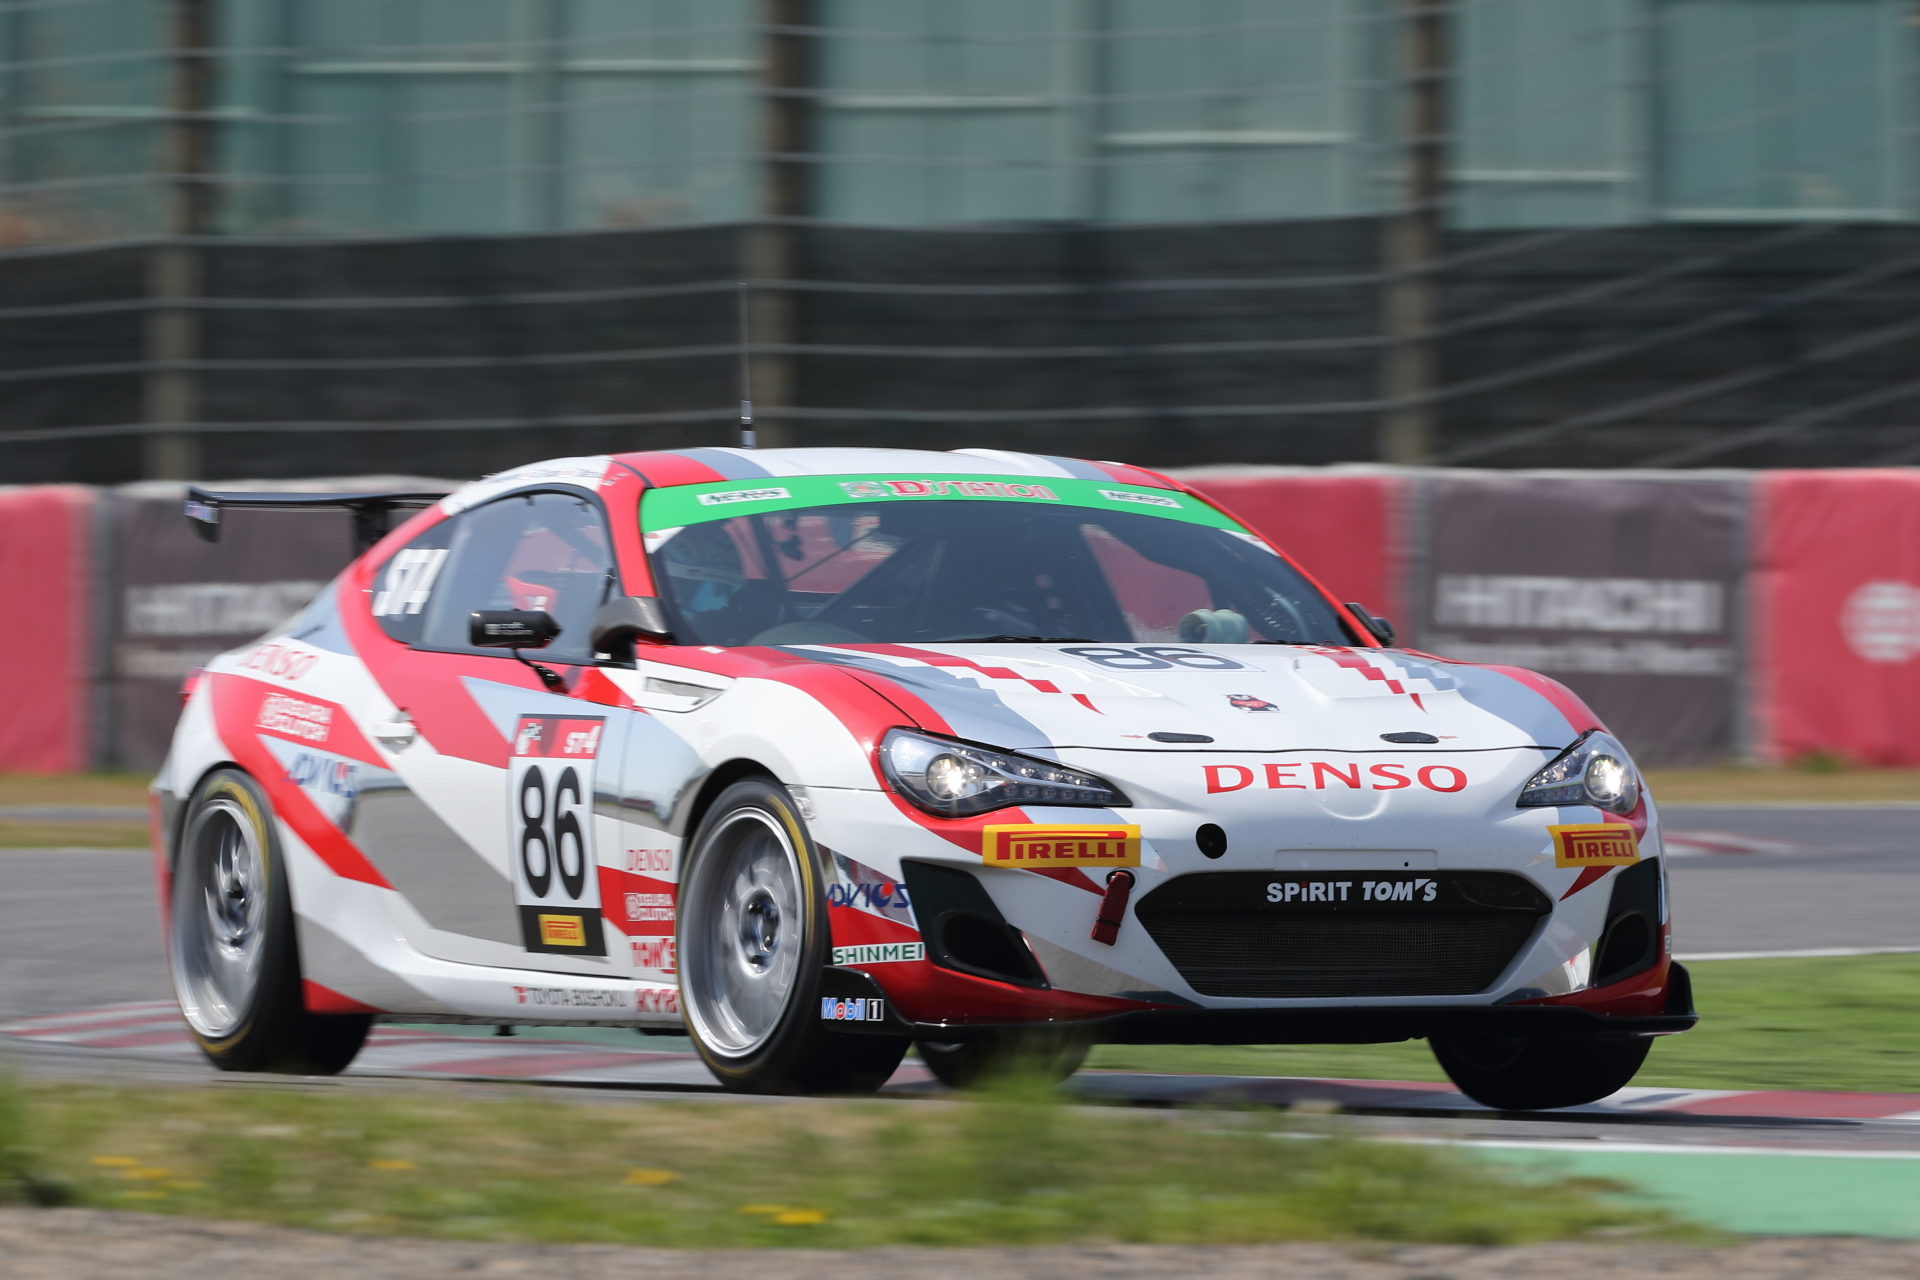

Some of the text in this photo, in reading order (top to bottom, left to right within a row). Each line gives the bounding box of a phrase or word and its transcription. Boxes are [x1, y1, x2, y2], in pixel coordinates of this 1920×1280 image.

[371, 548, 450, 616] ST4
[1433, 574, 1725, 633] HITACHI
[1058, 647, 1244, 669] 86
[1202, 762, 1468, 795] DENSO
[521, 765, 585, 900] 86
[996, 831, 1127, 860] PIRELLI
[1560, 830, 1634, 859] PIRELLI
[626, 849, 673, 871] DENSO
[1362, 879, 1438, 902] TOM'S
[546, 920, 580, 940] PIRELLI
[833, 944, 923, 965] SHINMEI
[821, 997, 866, 1021] Mobil
